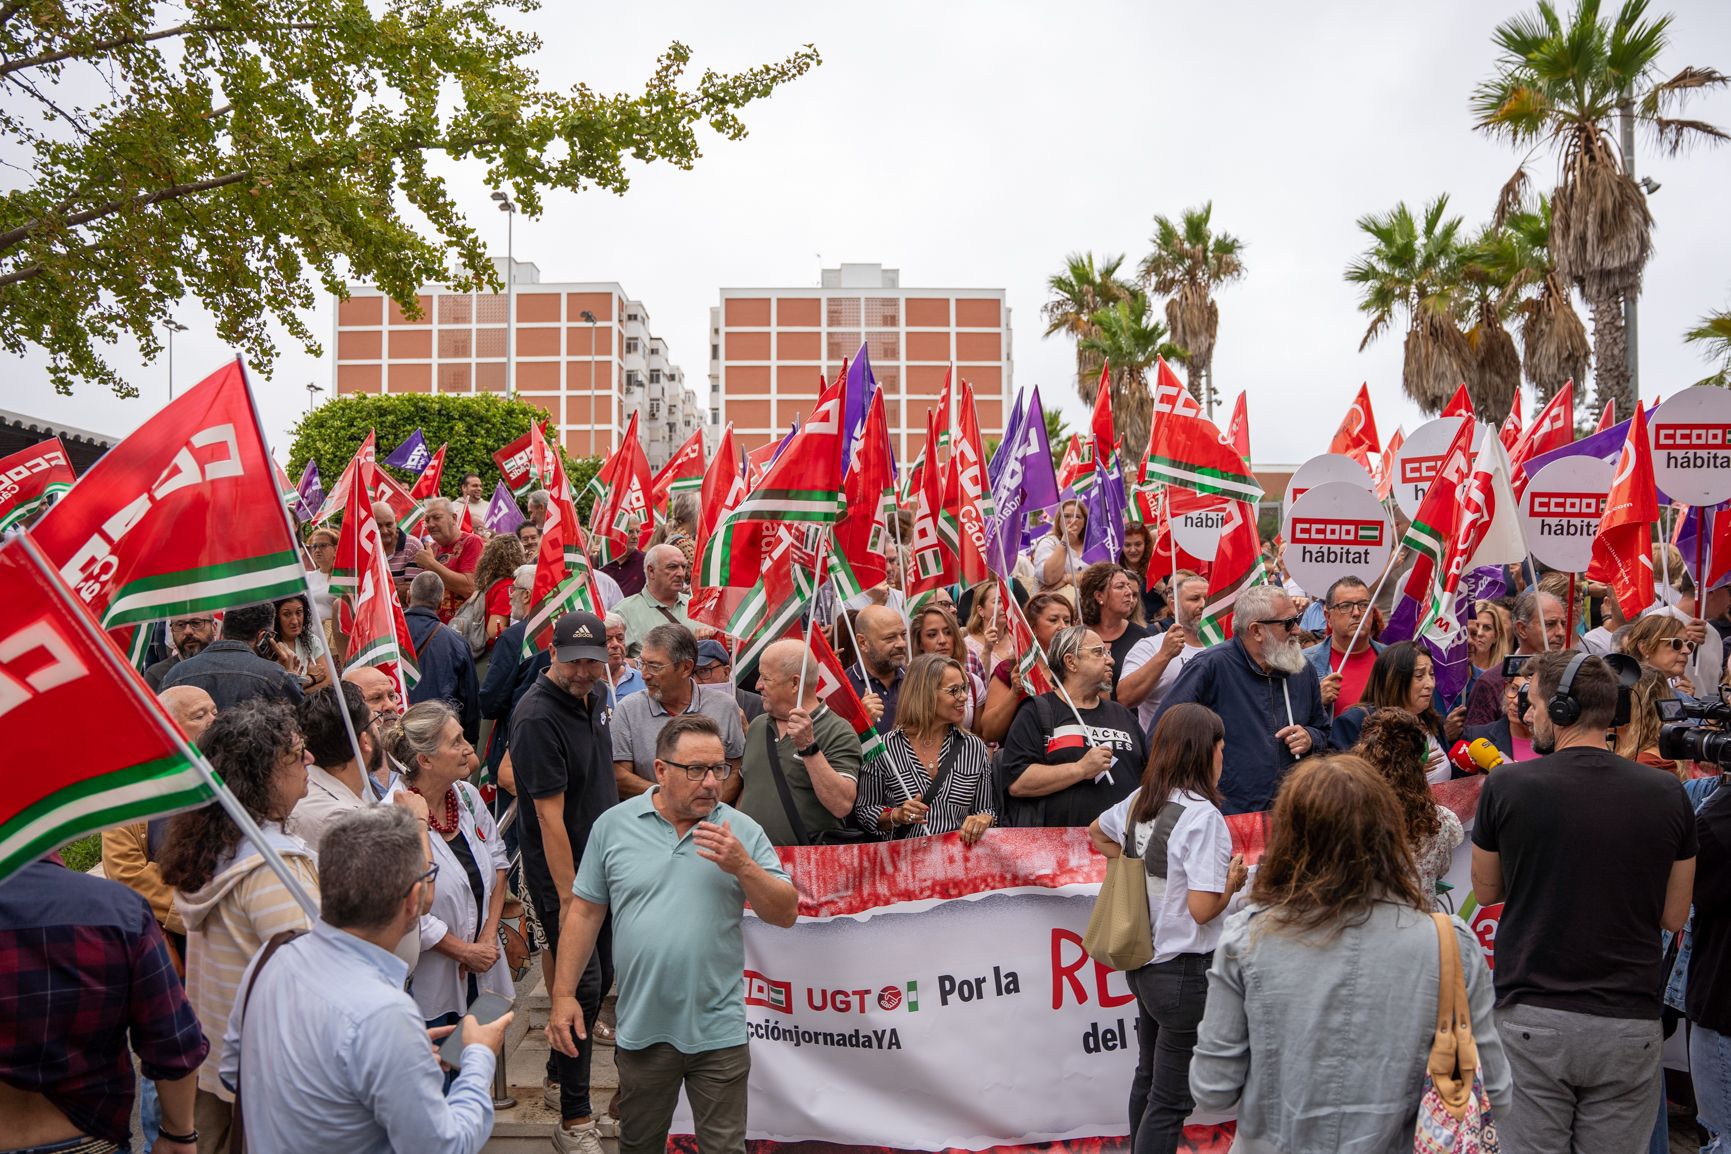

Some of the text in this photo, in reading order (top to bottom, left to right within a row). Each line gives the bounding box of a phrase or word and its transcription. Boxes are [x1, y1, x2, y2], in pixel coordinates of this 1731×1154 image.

[1659, 428, 1723, 445] CCOO
[1533, 497, 1596, 513] CCOO
[1295, 523, 1356, 540] CCOO
[1301, 546, 1370, 564] hábitat
[938, 974, 987, 1006] Por
[992, 965, 1021, 997] la
[806, 987, 872, 1014] UGT
[1082, 1018, 1128, 1054] del
